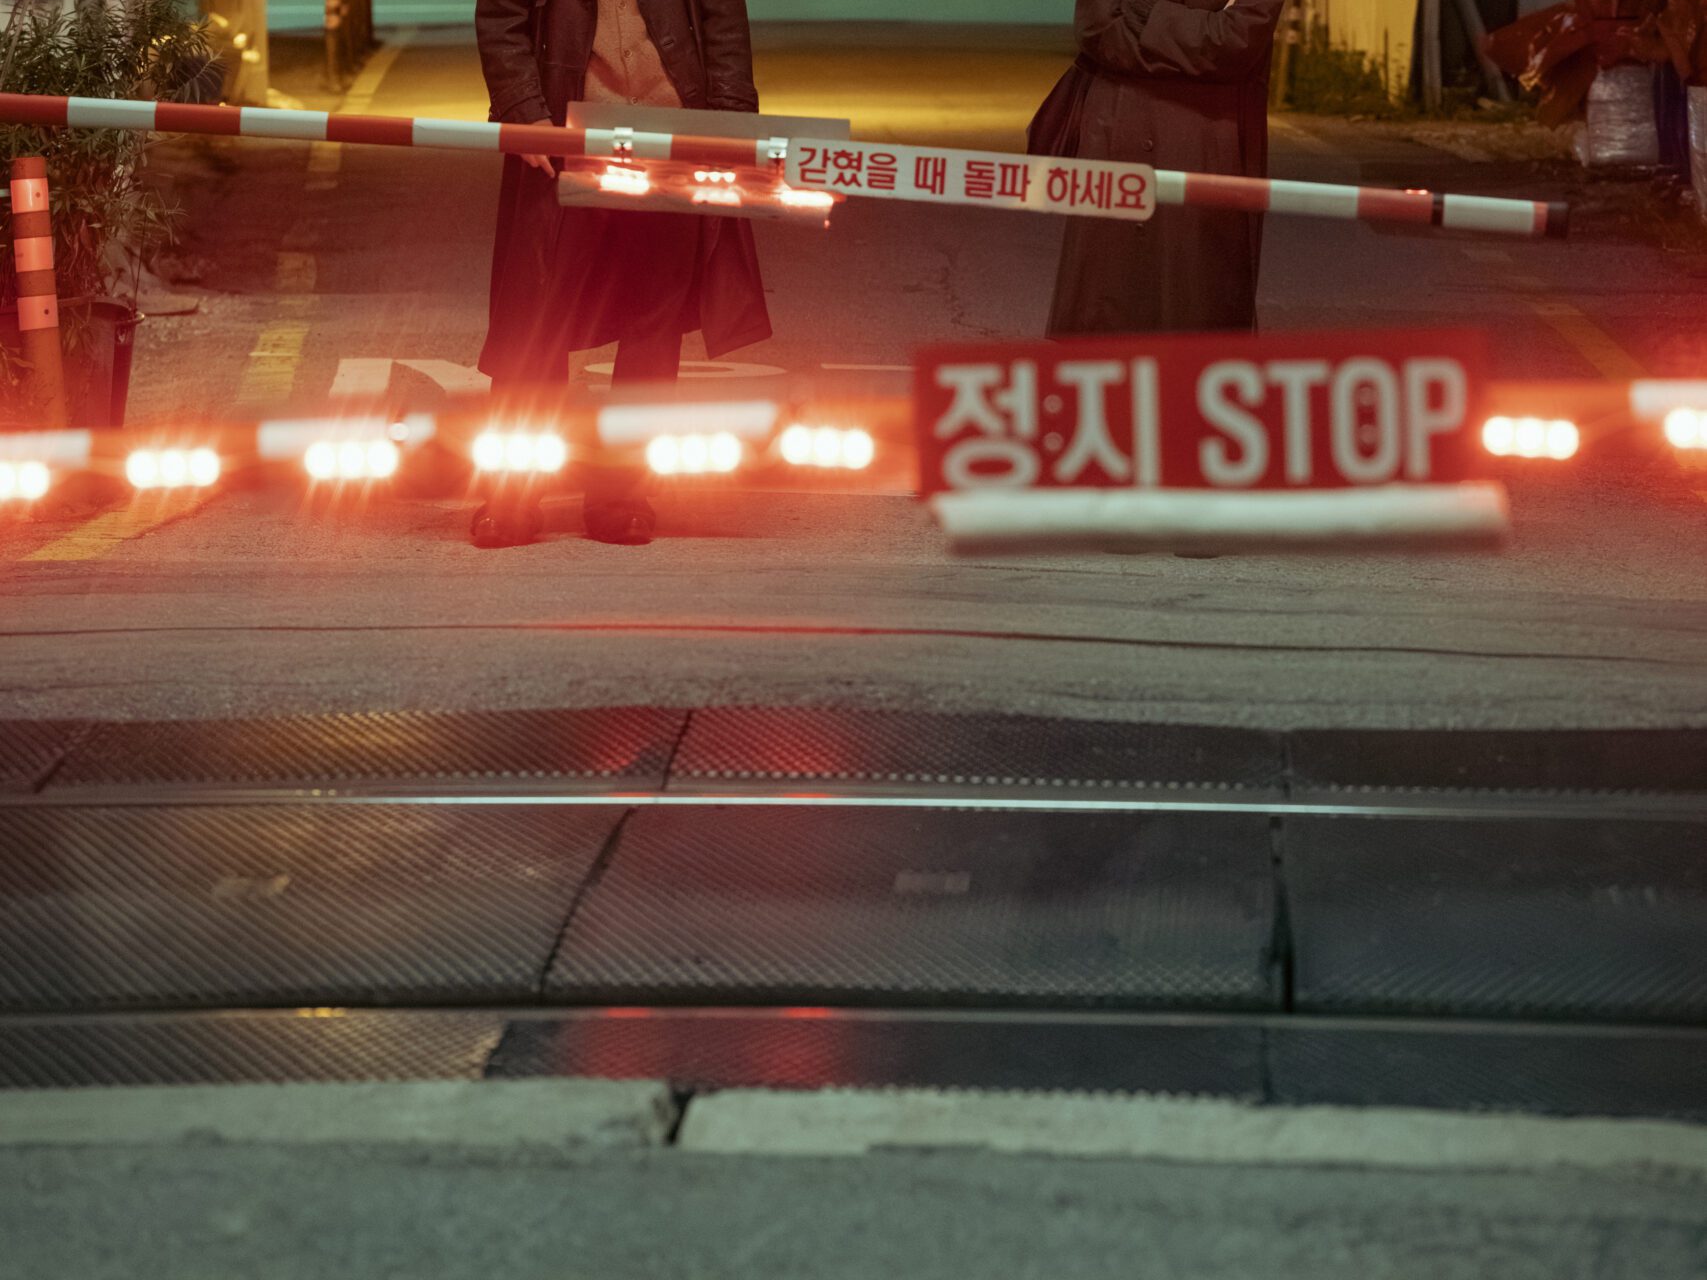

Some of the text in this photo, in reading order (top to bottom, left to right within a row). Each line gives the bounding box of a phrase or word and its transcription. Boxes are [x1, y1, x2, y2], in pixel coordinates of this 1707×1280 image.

[798, 147, 1147, 210] 갇혔을 때 돌파 하세요
[934, 356, 1468, 488] 정지 STOP
